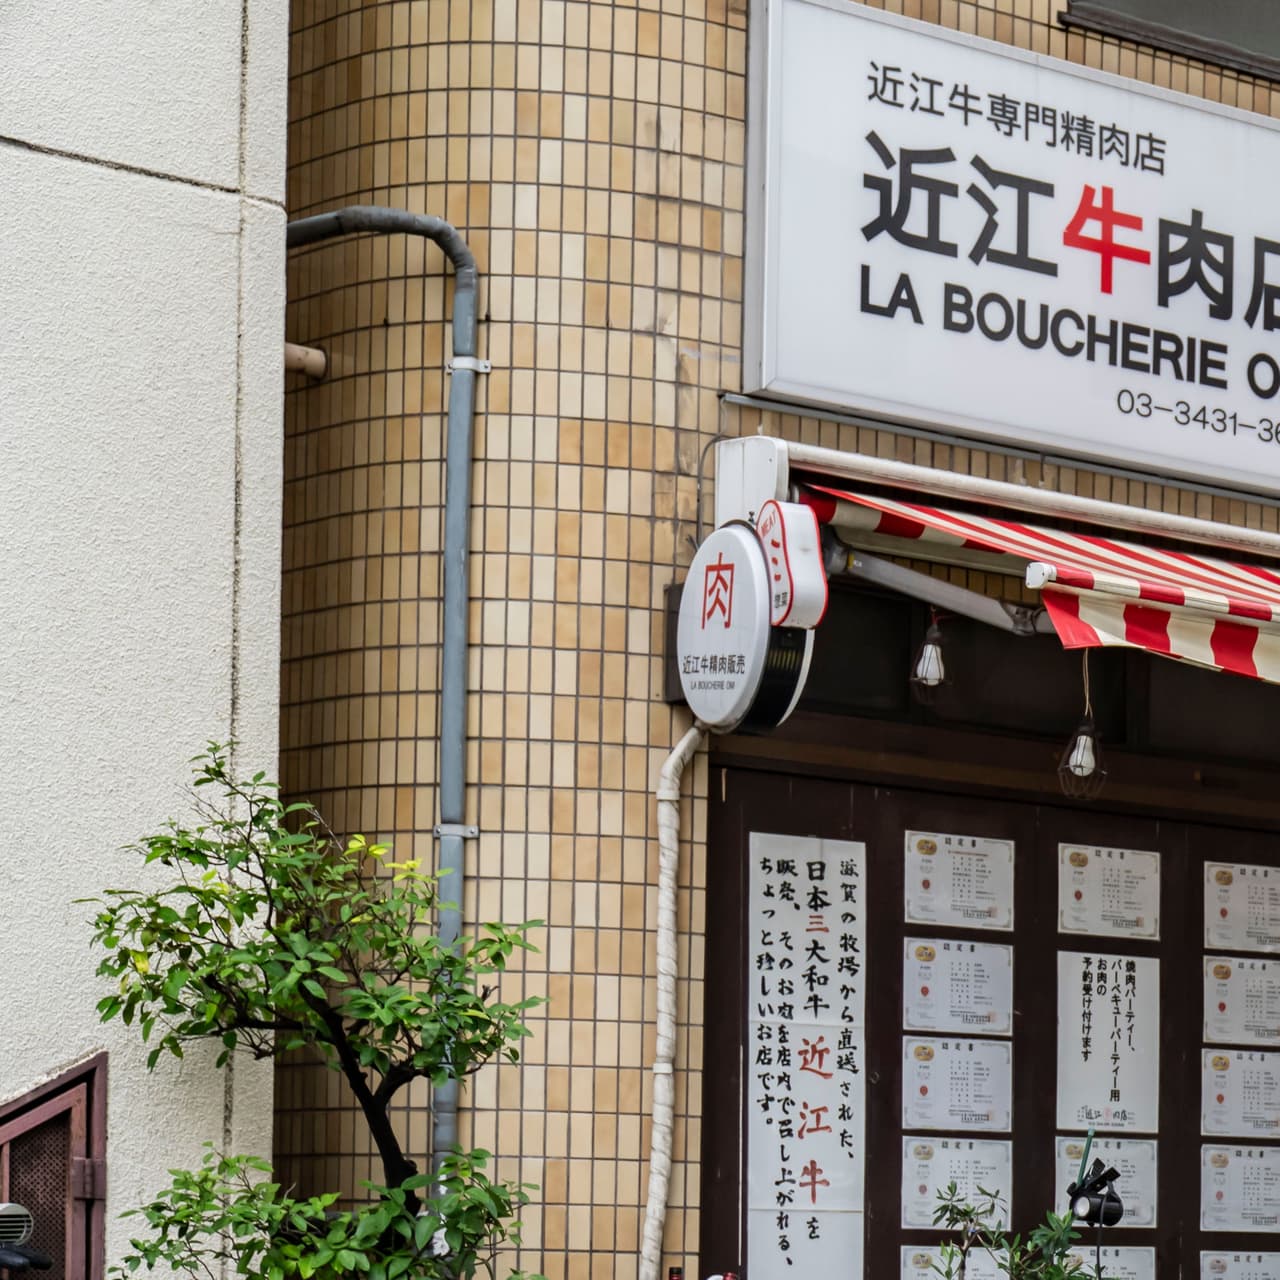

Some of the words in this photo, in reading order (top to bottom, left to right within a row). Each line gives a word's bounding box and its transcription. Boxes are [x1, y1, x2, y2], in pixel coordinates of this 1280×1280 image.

[866, 61, 1167, 176] 近江牛専門精肉店
[860, 264, 924, 324] LA
[943, 282, 1228, 390] BOUCHERIE
[702, 552, 735, 630] 肉
